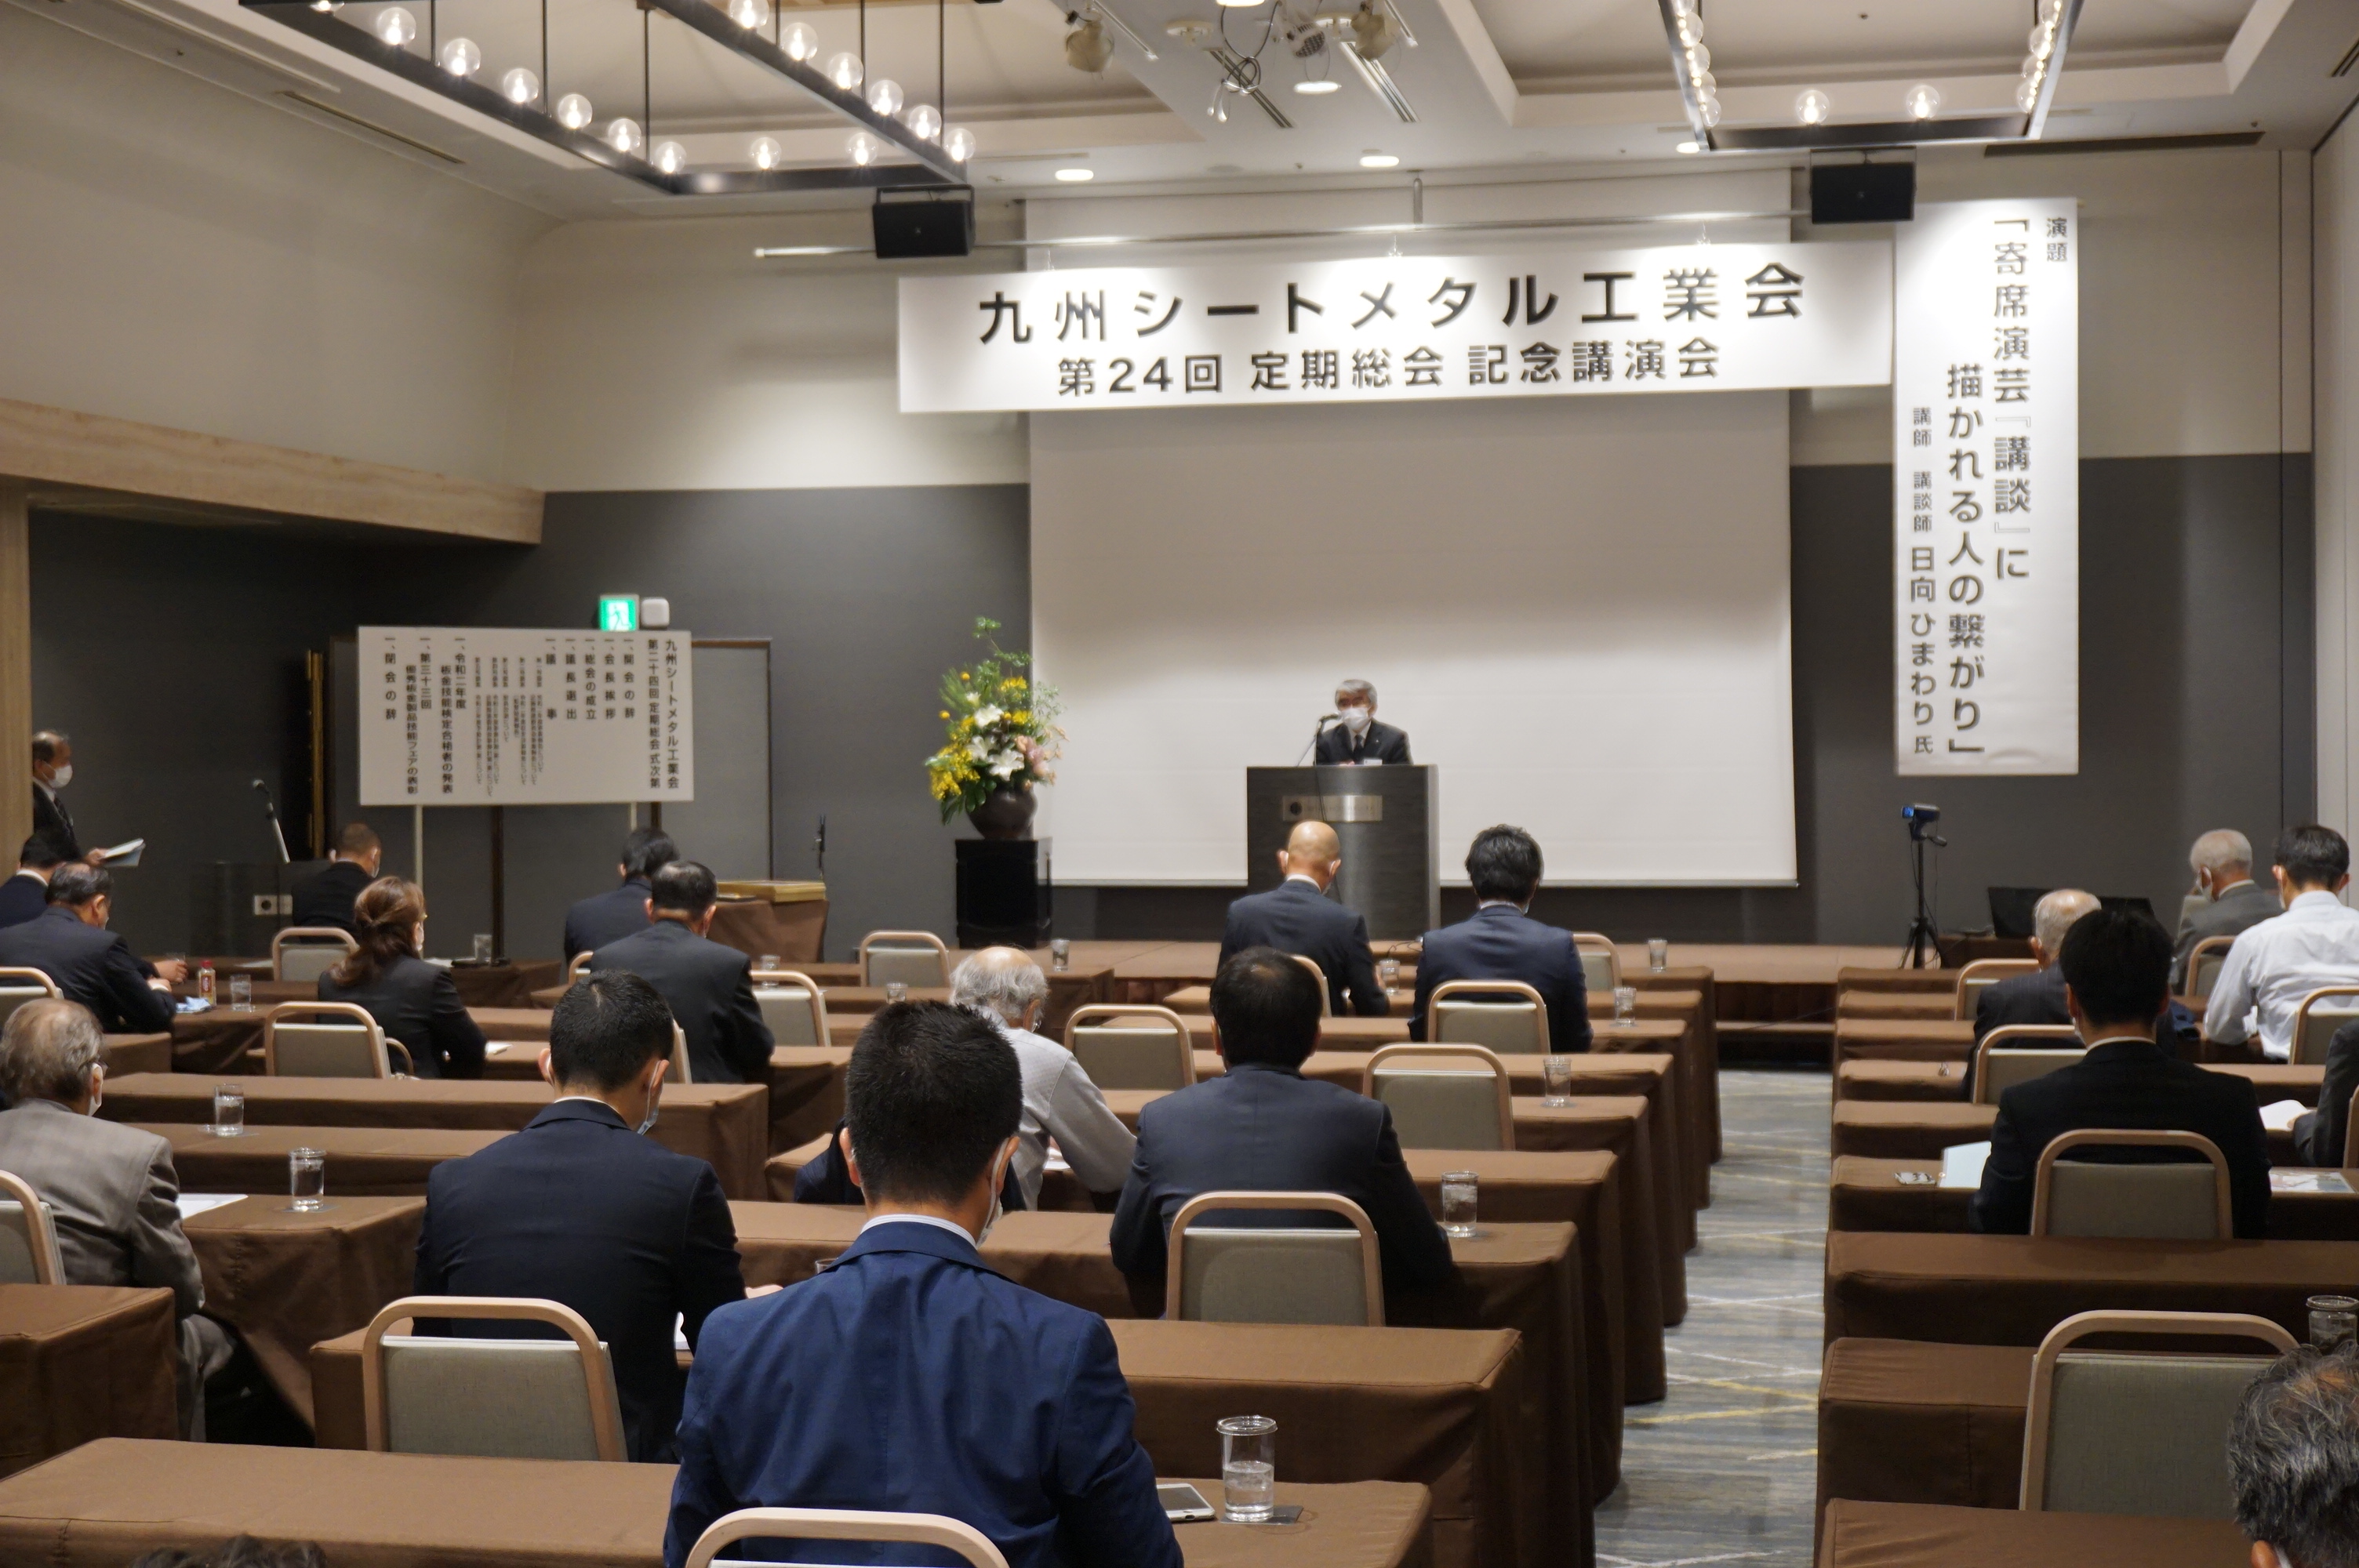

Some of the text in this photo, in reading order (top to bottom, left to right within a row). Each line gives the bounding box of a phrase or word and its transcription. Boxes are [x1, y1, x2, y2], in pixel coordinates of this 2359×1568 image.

[977, 260, 1806, 347] 九州シートメタル工業会
[1057, 334, 1722, 398] 第24回 定期総会 記念講演会
[1946, 362, 1986, 755] 描かれる人の繋がり」
[665, 638, 680, 789] 九州シートメタル工業会
